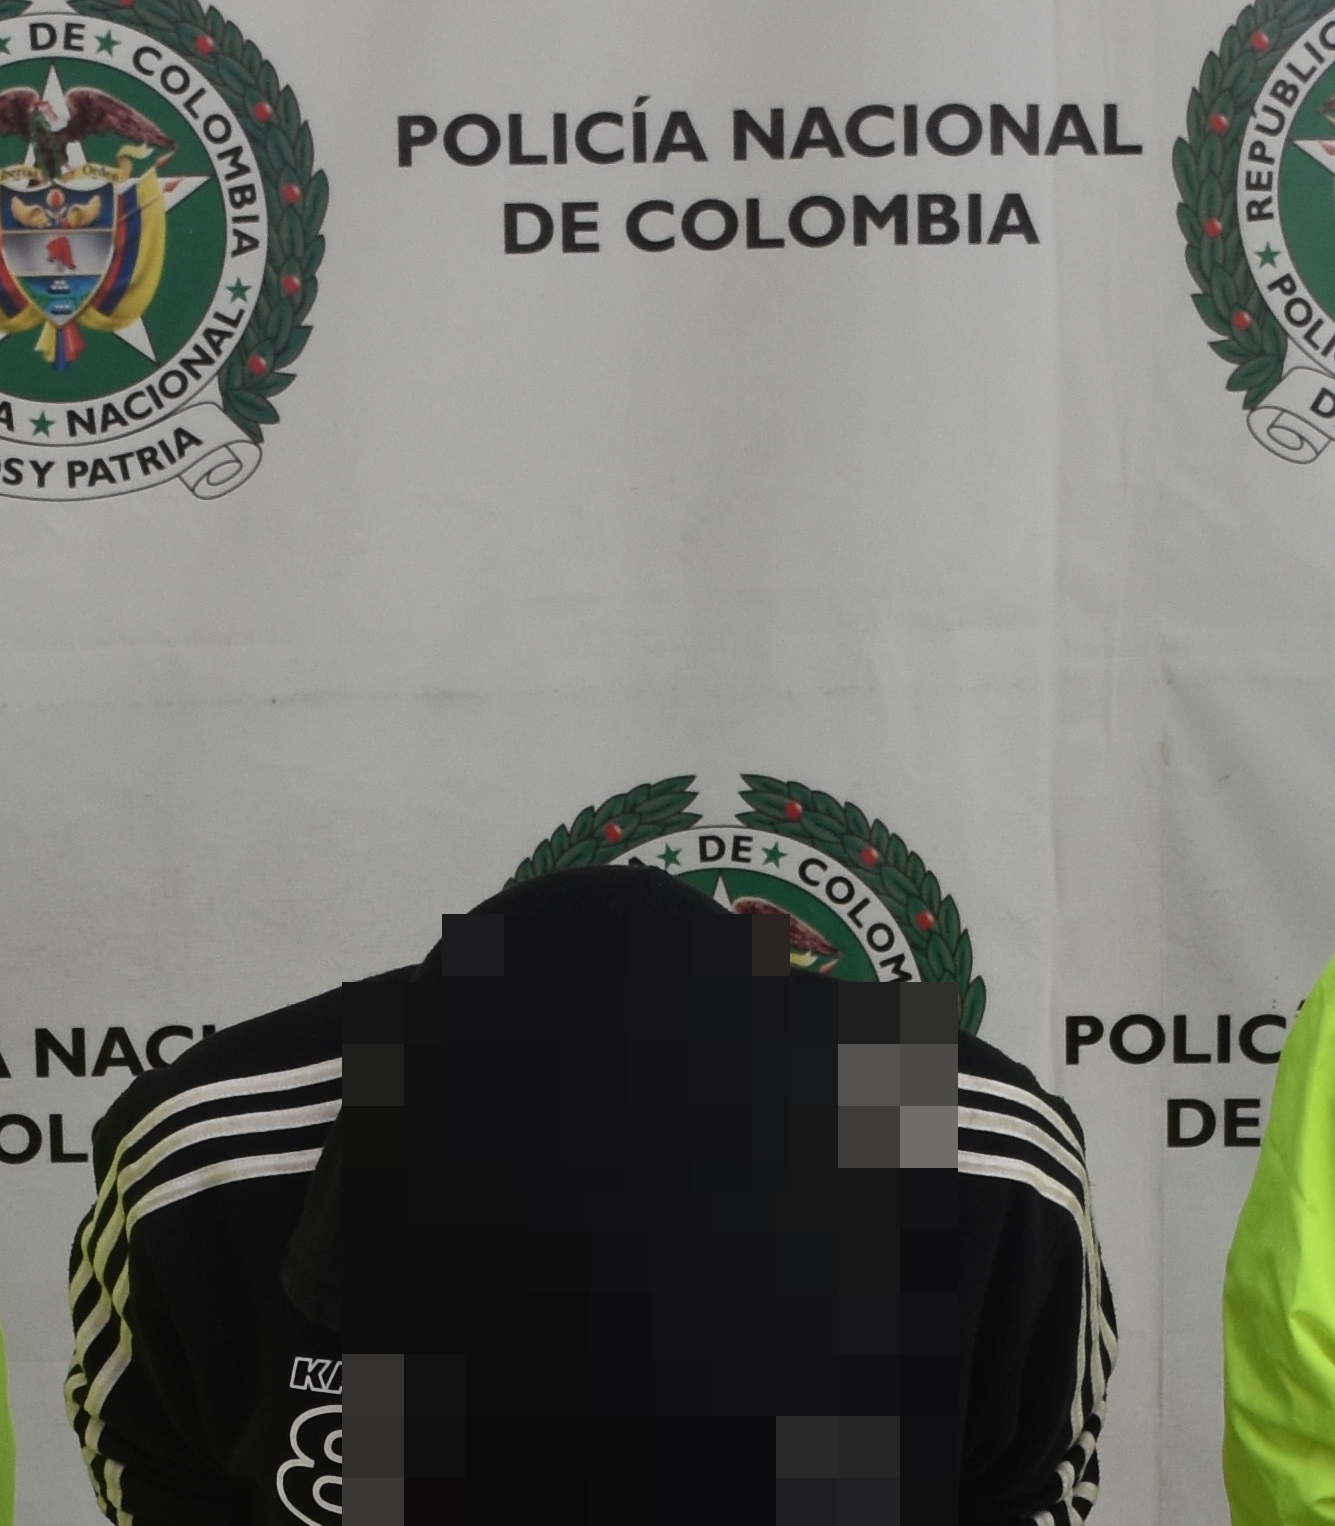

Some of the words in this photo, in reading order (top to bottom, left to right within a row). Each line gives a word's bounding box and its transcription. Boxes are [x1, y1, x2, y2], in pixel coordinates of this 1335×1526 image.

[30, 22, 86, 52] DE
[132, 46, 259, 258] COLOMBIA
[396, 96, 707, 168] POLICÍA
[732, 104, 1143, 160] NACIONAL
[503, 201, 599, 255] DE
[626, 193, 1040, 251] COLOMBIA
[66, 307, 245, 437] NACIONAL
[68, 426, 203, 488] PATRIA
[698, 835, 753, 864] DE
[1066, 1000, 1307, 1065] POLIC
[1167, 1098, 1261, 1147] DE
